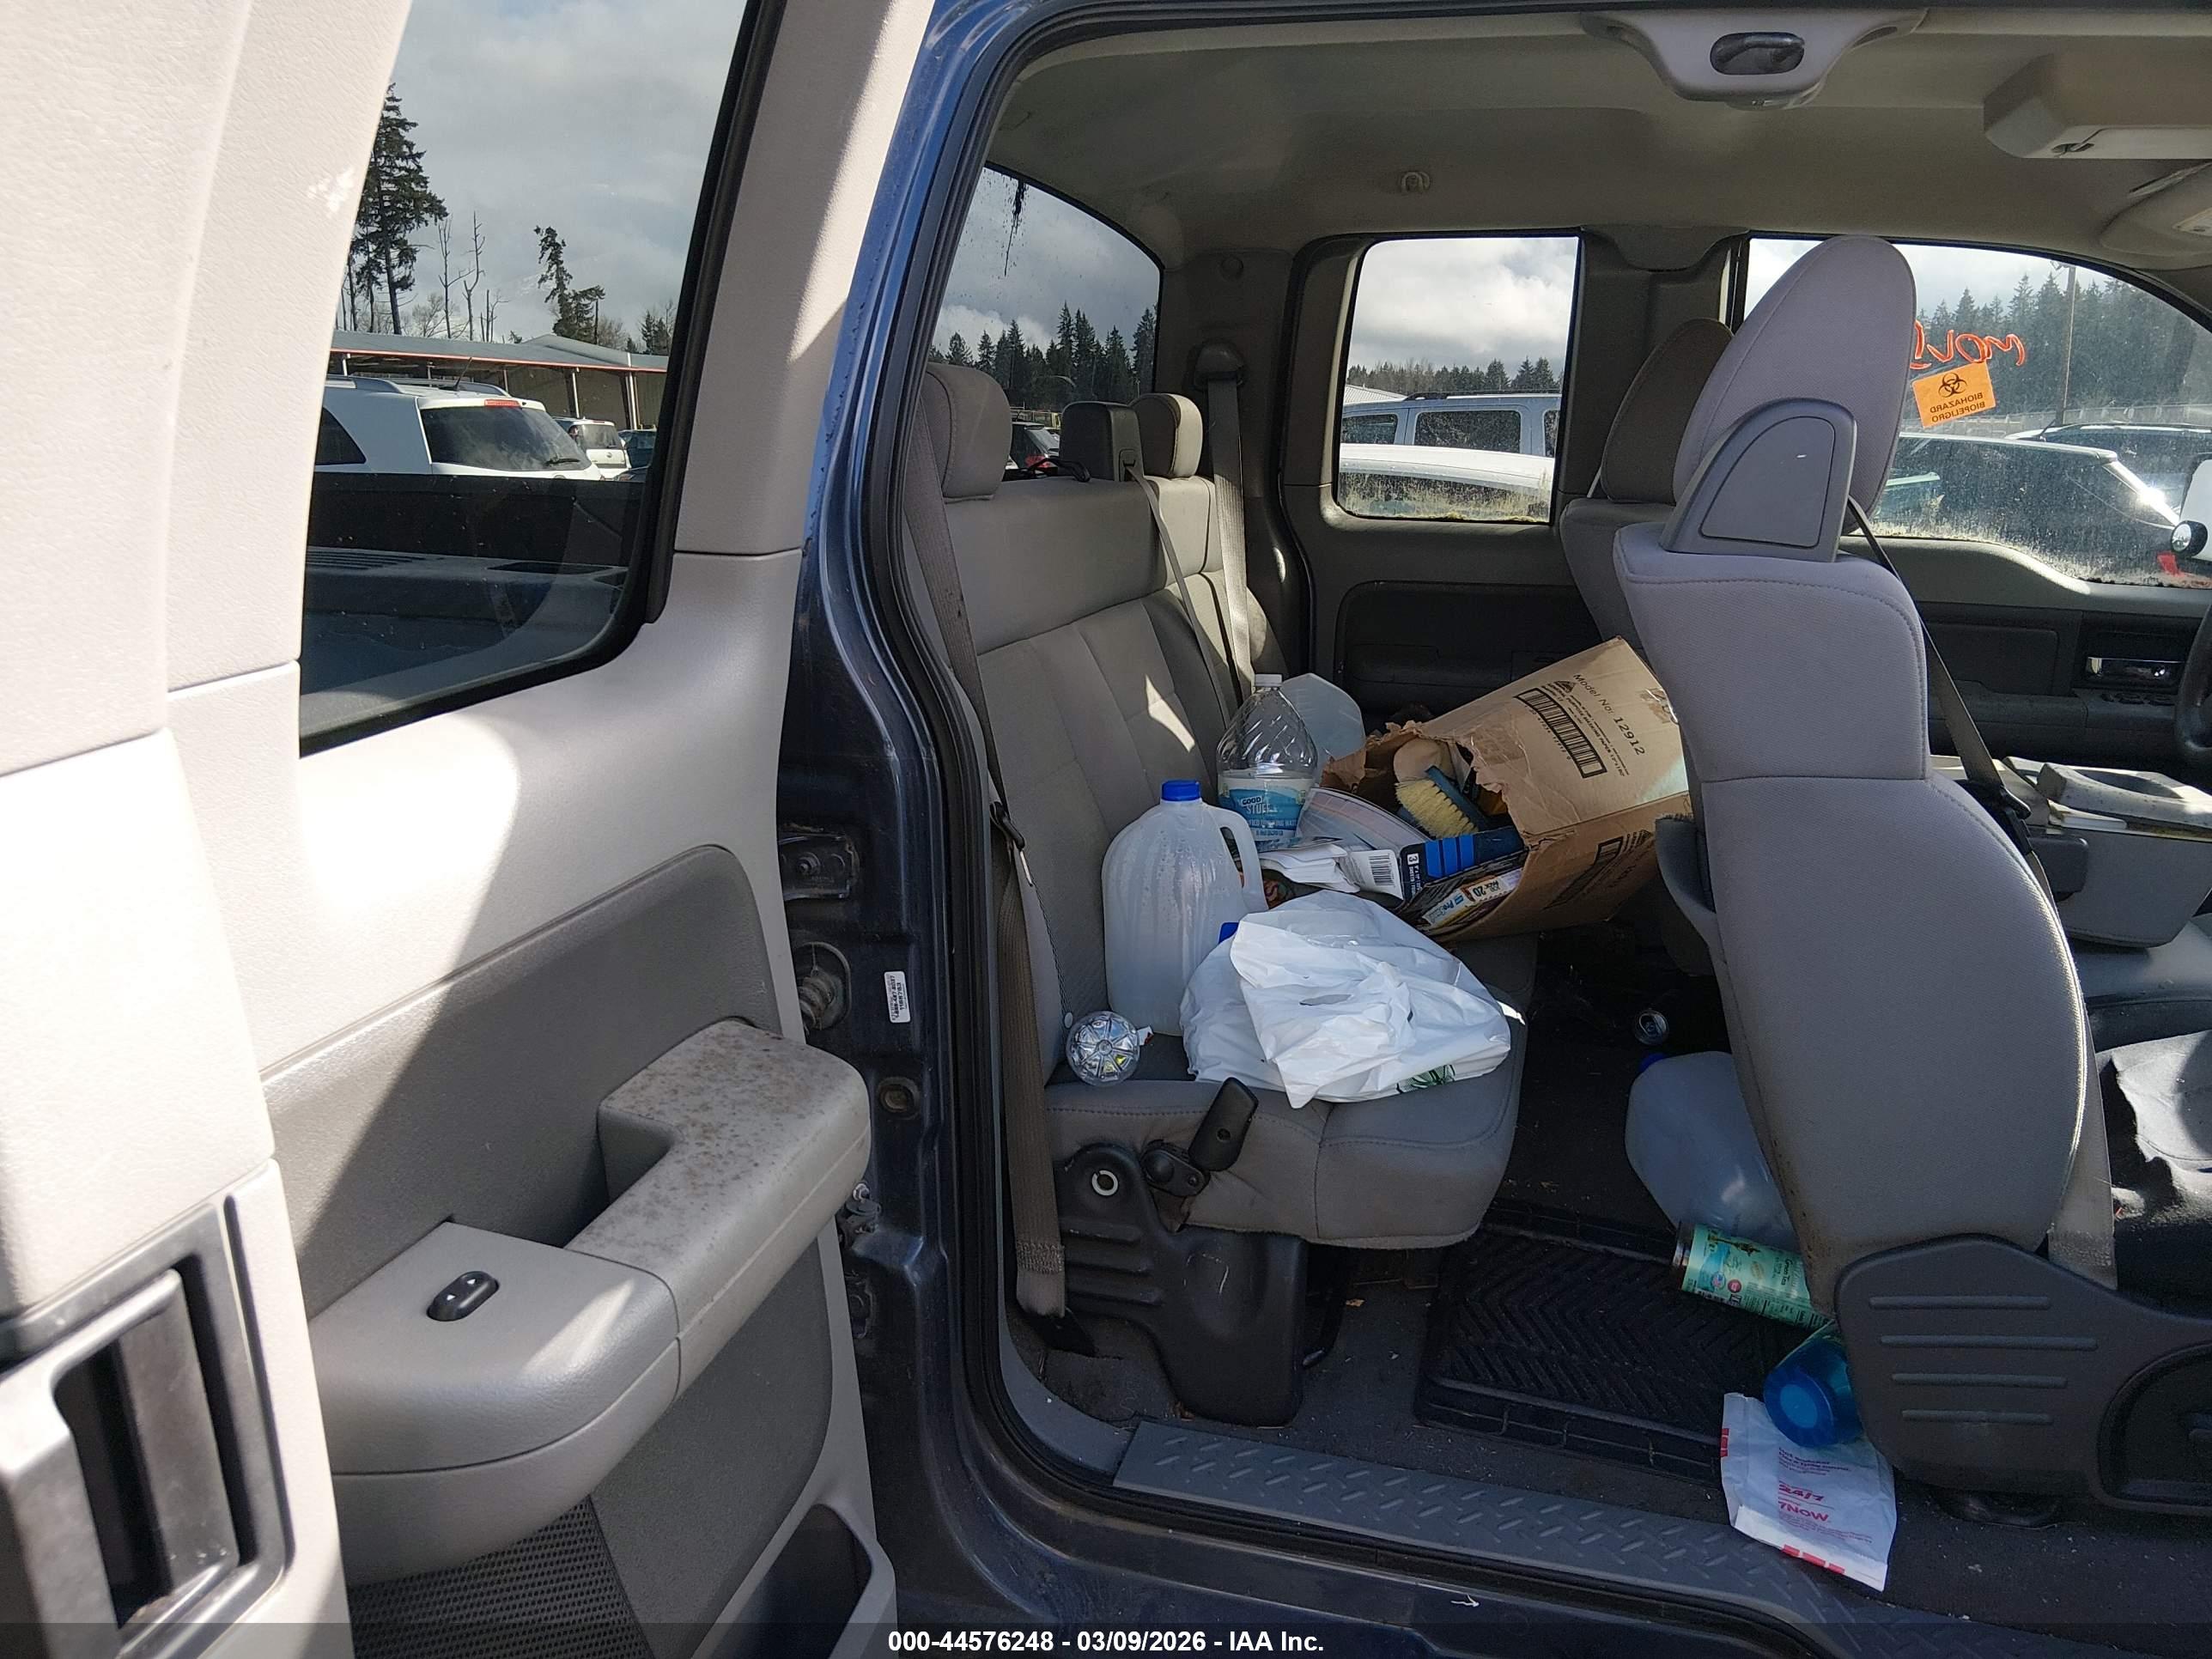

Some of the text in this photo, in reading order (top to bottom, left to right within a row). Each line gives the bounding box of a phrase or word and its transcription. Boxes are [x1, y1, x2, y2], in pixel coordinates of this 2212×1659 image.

[1573, 674, 1601, 697] Model
[1598, 698, 1615, 714] No:
[1613, 716, 1645, 756] 12912
[1242, 796, 1261, 805] GOOD
[1472, 886, 1486, 897] 20
[1778, 1500, 1829, 1522] 7NOW
